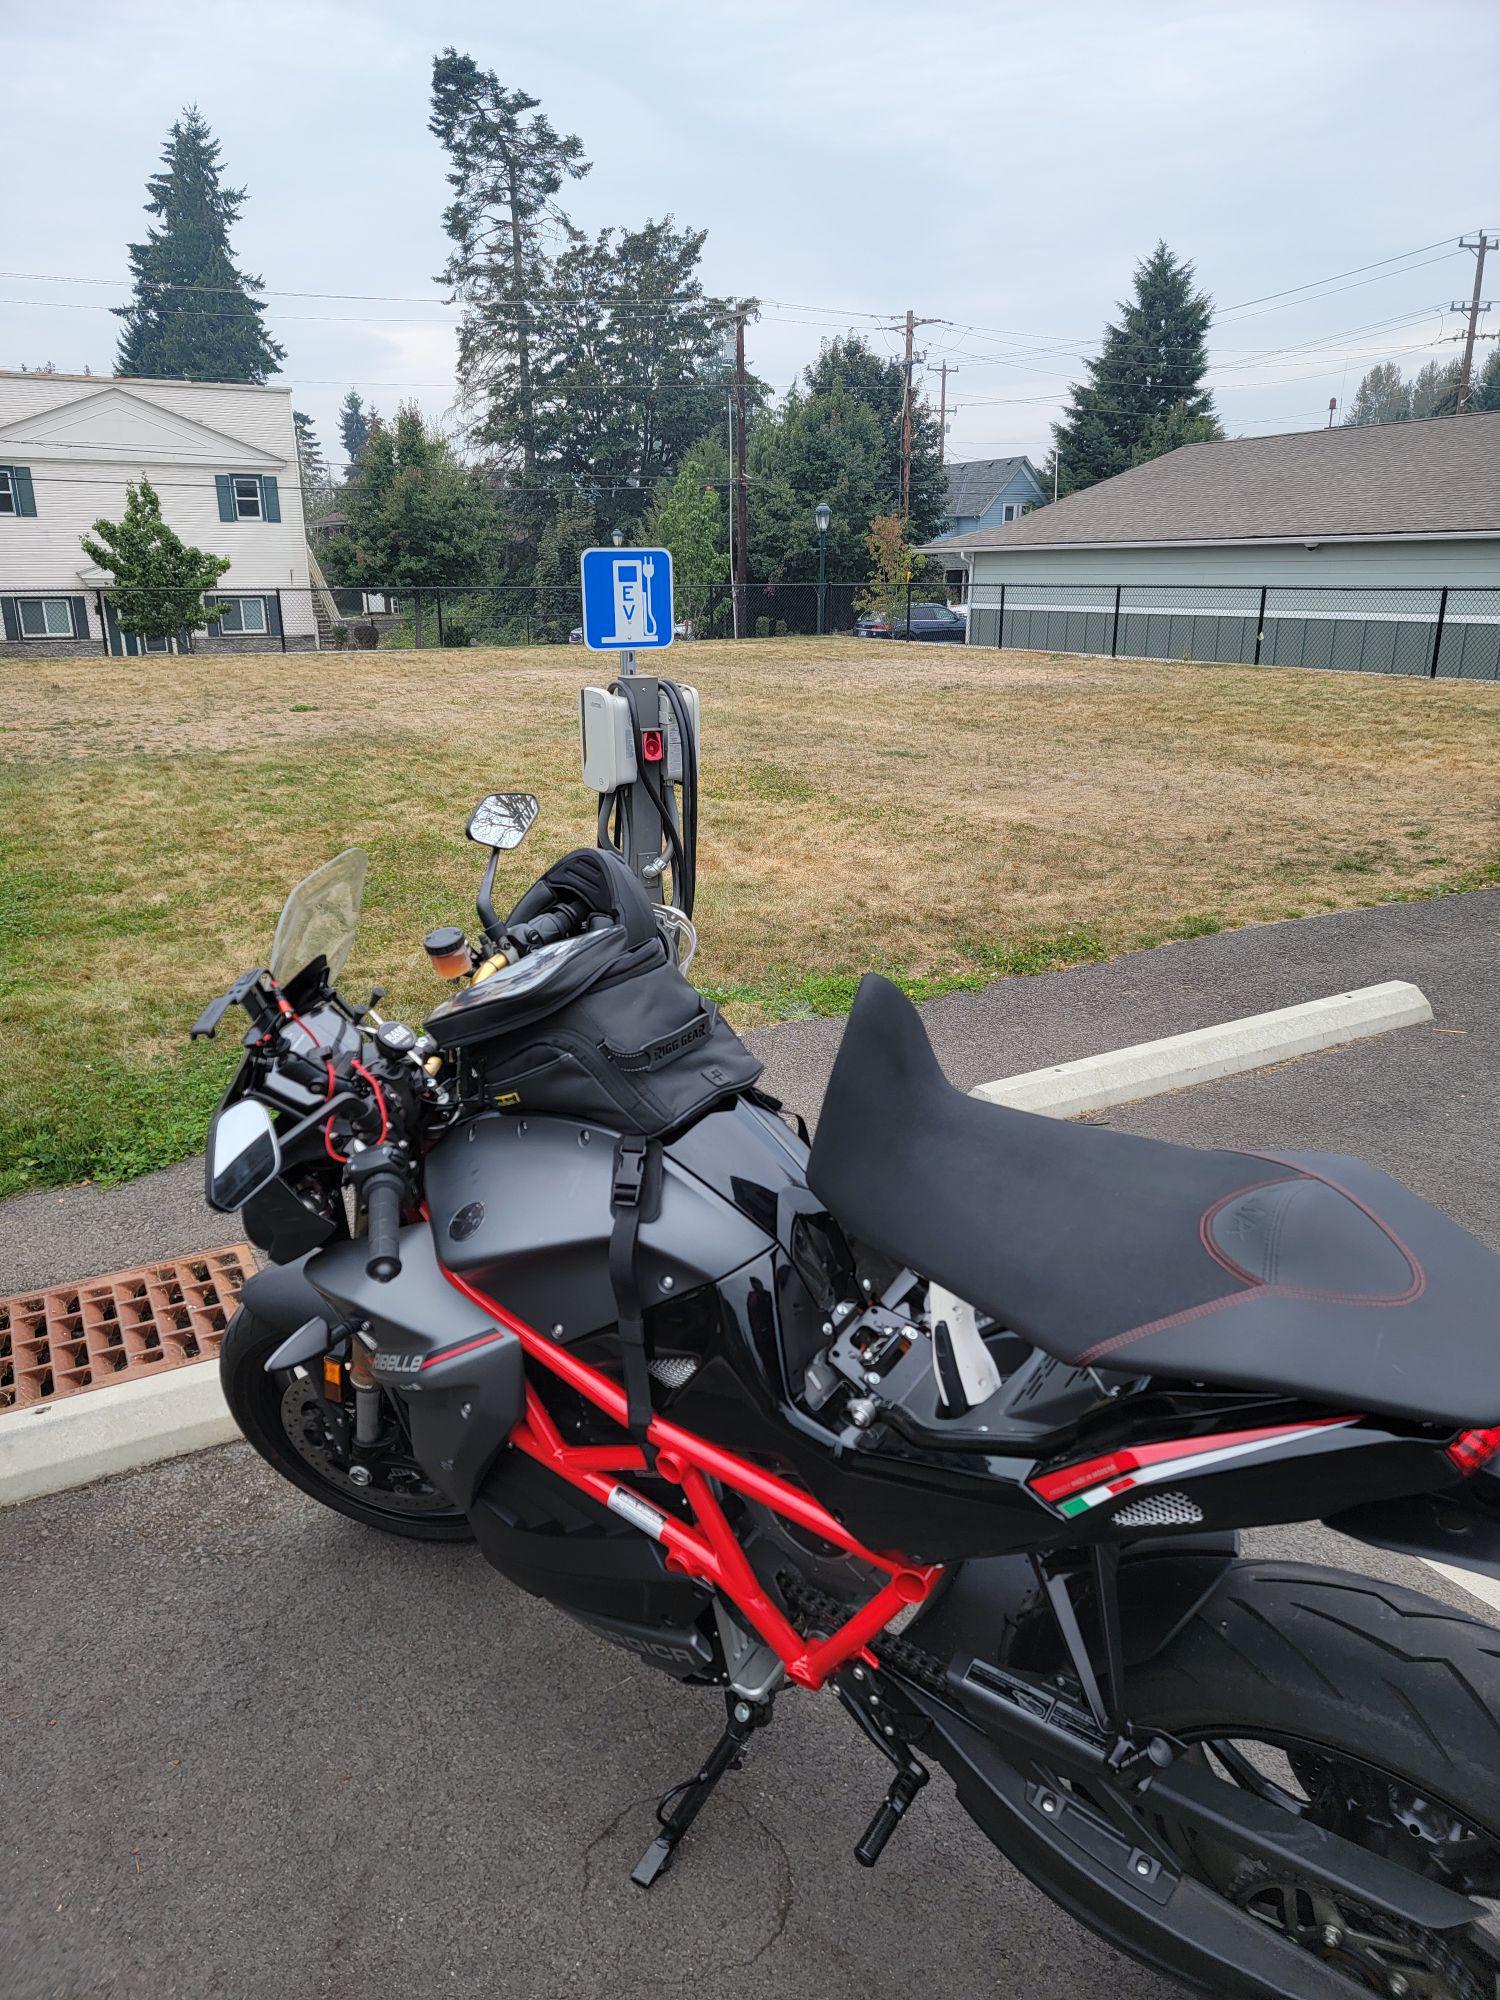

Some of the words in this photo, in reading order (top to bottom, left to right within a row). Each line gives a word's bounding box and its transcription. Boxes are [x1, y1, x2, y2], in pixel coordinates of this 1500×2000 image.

[622, 585, 635, 621] EV
[654, 1039, 679, 1061] RIGG
[680, 1023, 707, 1046] GEAR
